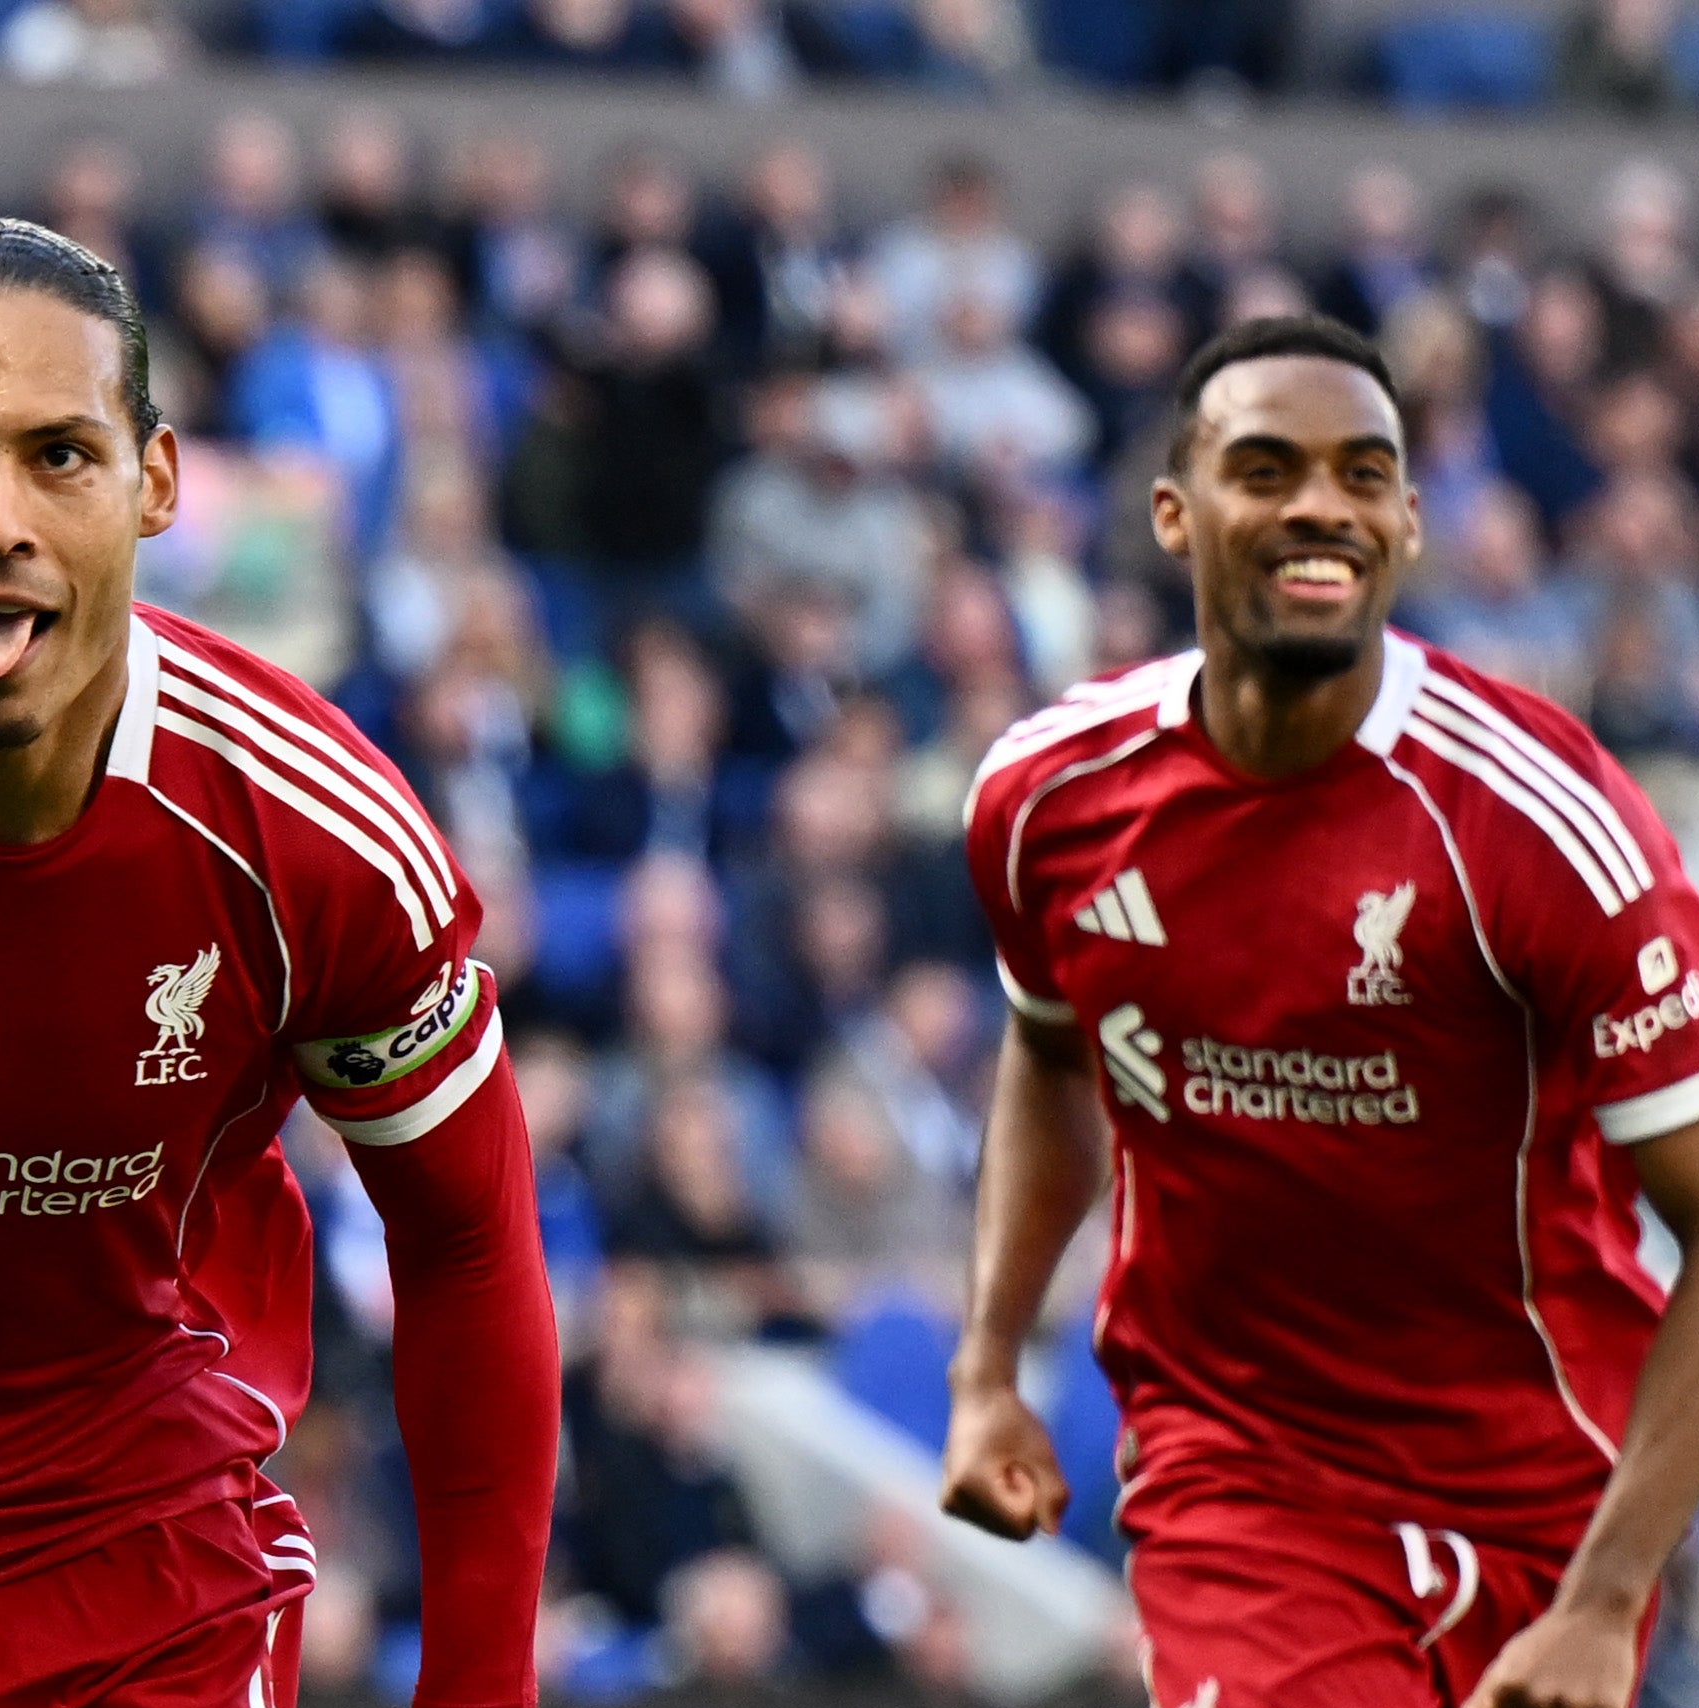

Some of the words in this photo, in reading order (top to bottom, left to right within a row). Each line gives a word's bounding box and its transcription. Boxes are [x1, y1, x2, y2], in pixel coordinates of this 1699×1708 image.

[388, 962, 467, 1059] Capt
[1180, 1034, 1400, 1091] standard
[1182, 1073, 1420, 1126] chartered
